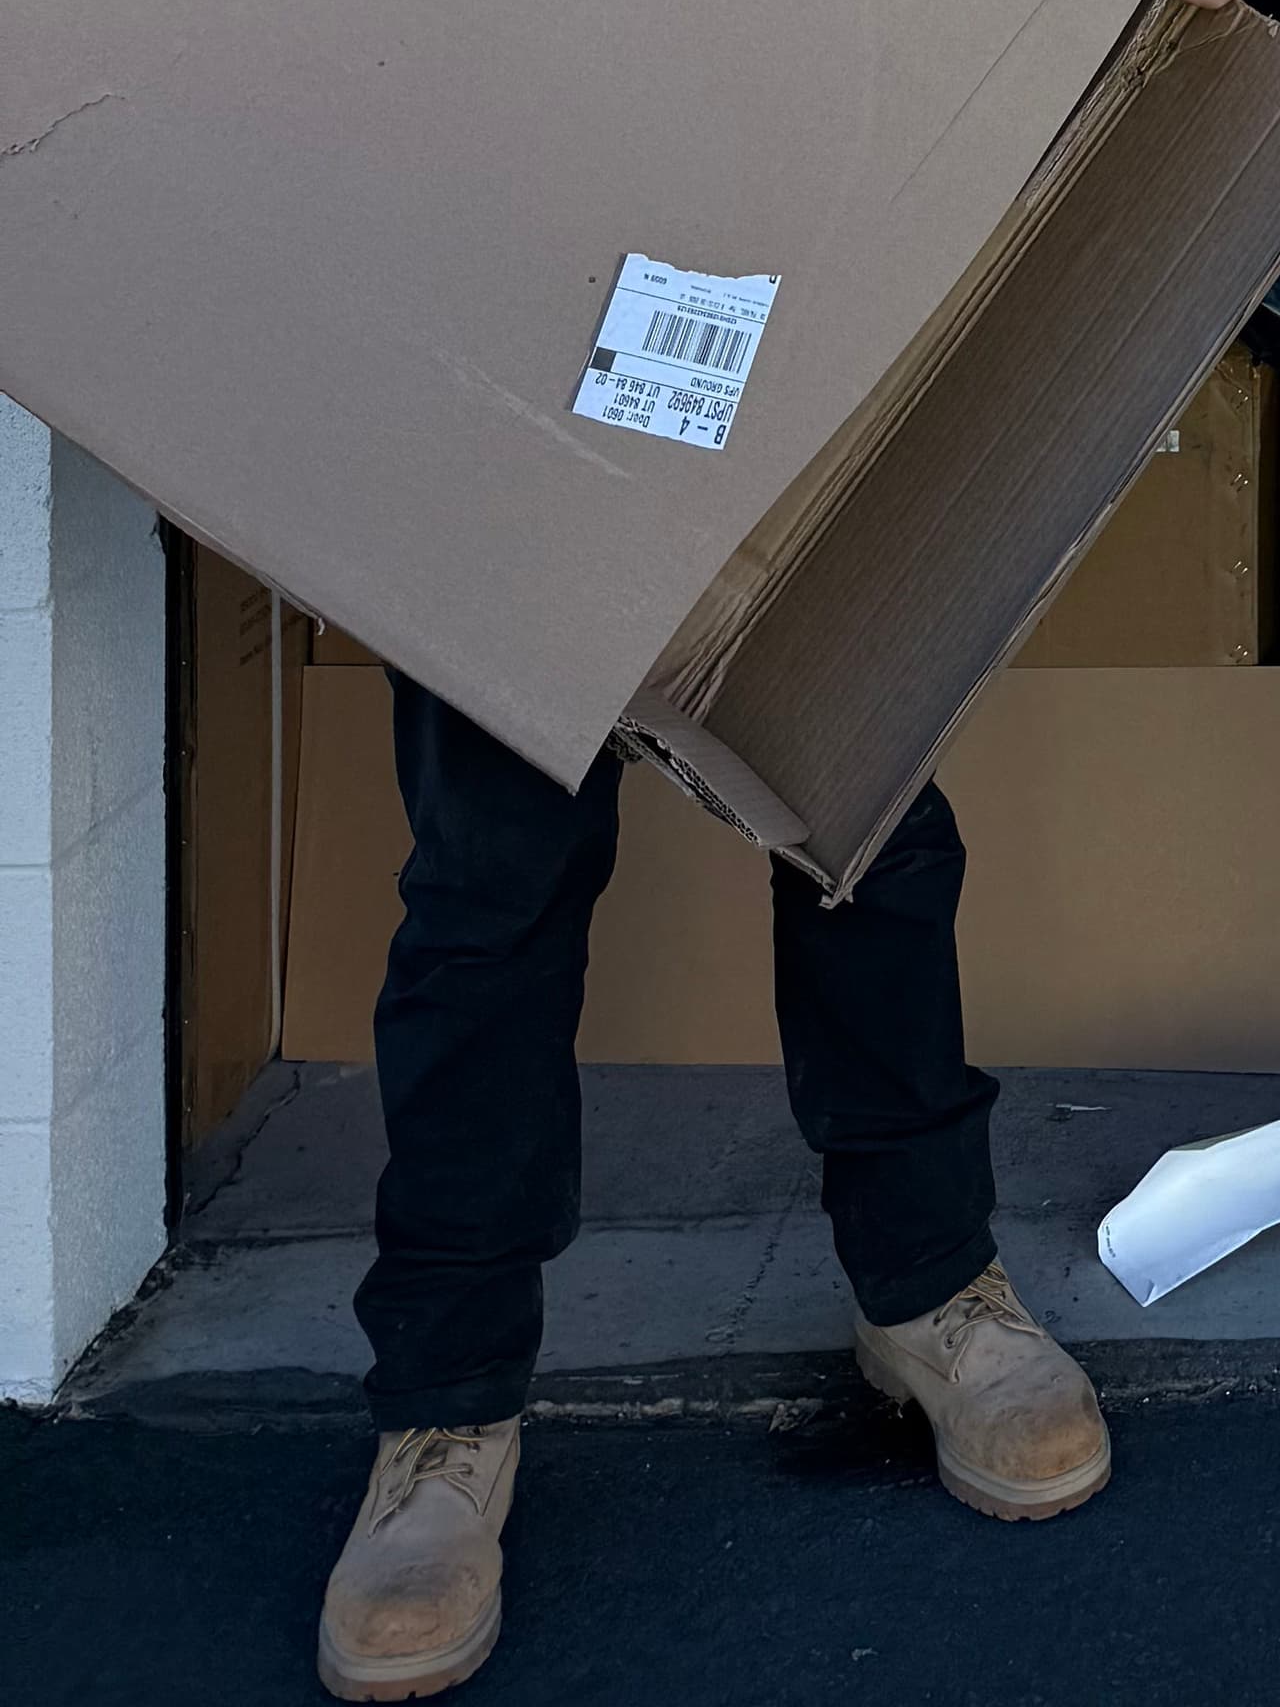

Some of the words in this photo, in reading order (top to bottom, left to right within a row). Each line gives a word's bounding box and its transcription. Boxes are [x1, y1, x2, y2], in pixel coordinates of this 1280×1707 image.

[628, 380, 645, 394] 846
[652, 386, 661, 400] UT
[690, 376, 722, 394] GROUND
[722, 384, 740, 398] UPS
[613, 393, 641, 412] 84601
[646, 399, 656, 413] UT
[667, 390, 702, 416] 849692
[704, 402, 734, 421] UPST
[627, 413, 651, 429] Door:
[679, 416, 689, 436] 4
[714, 424, 728, 446] B
